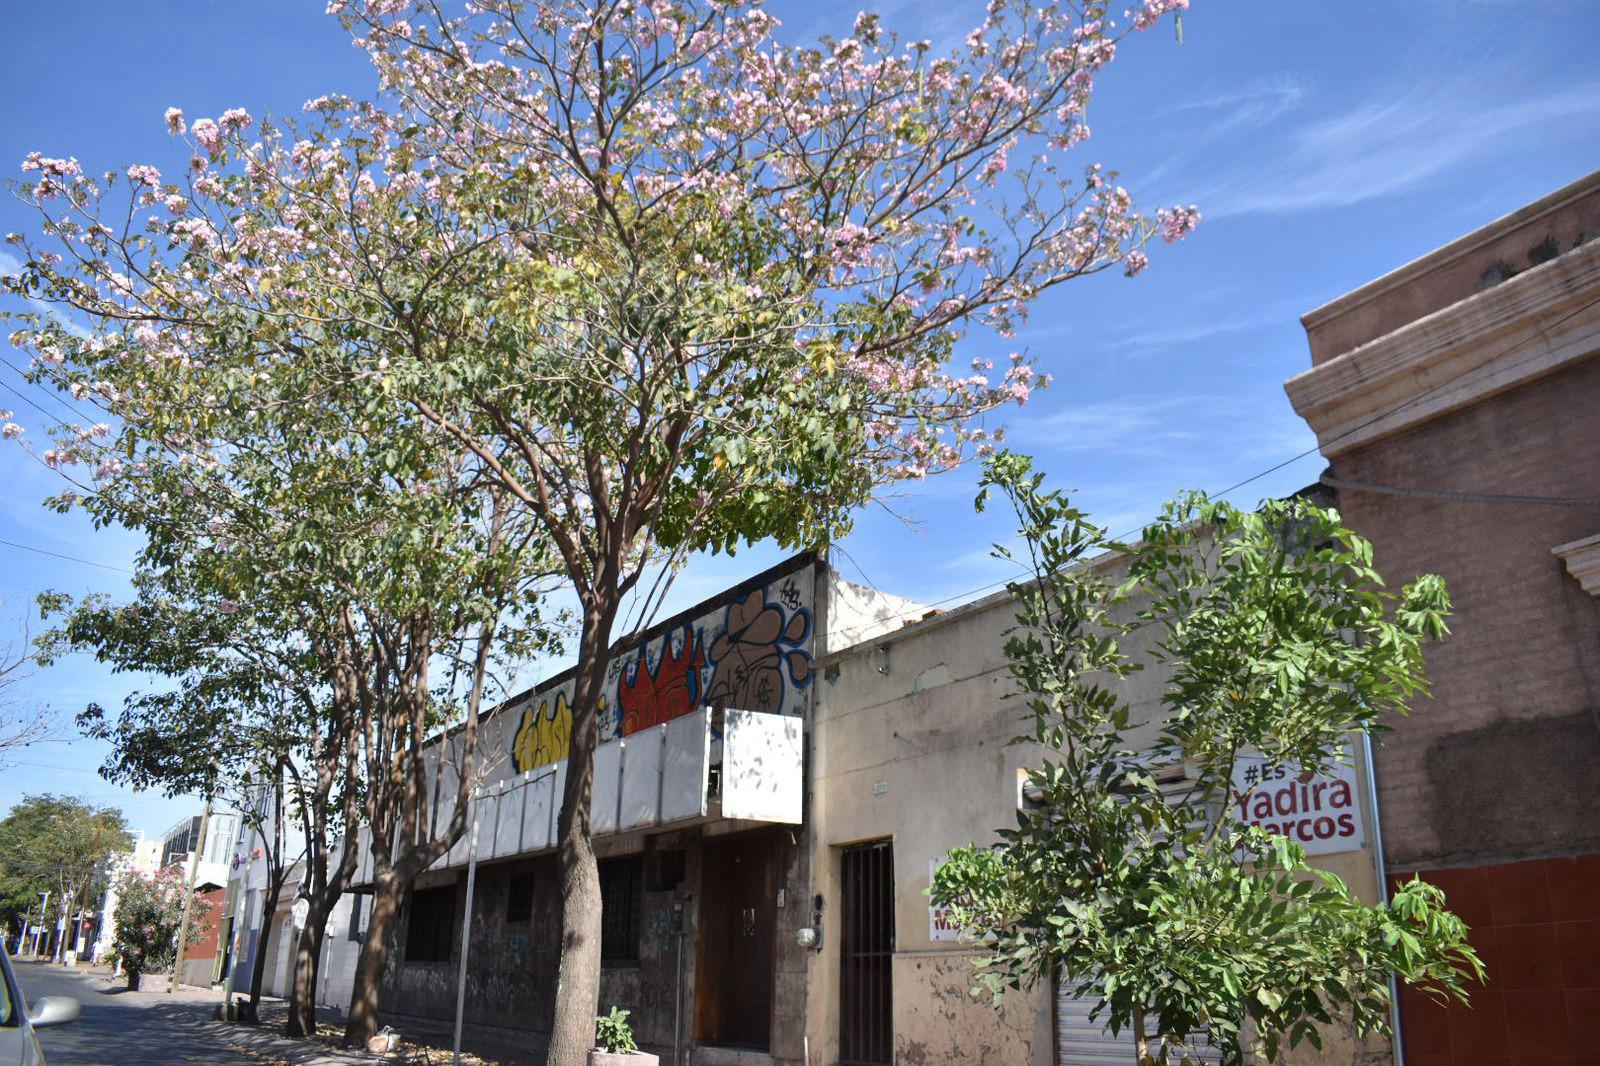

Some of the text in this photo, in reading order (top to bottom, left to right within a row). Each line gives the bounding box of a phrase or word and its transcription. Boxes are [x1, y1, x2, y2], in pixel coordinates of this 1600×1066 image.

[1244, 762, 1286, 784] #Es
[1232, 779, 1353, 821] Yadira
[1239, 813, 1356, 846] arcos
